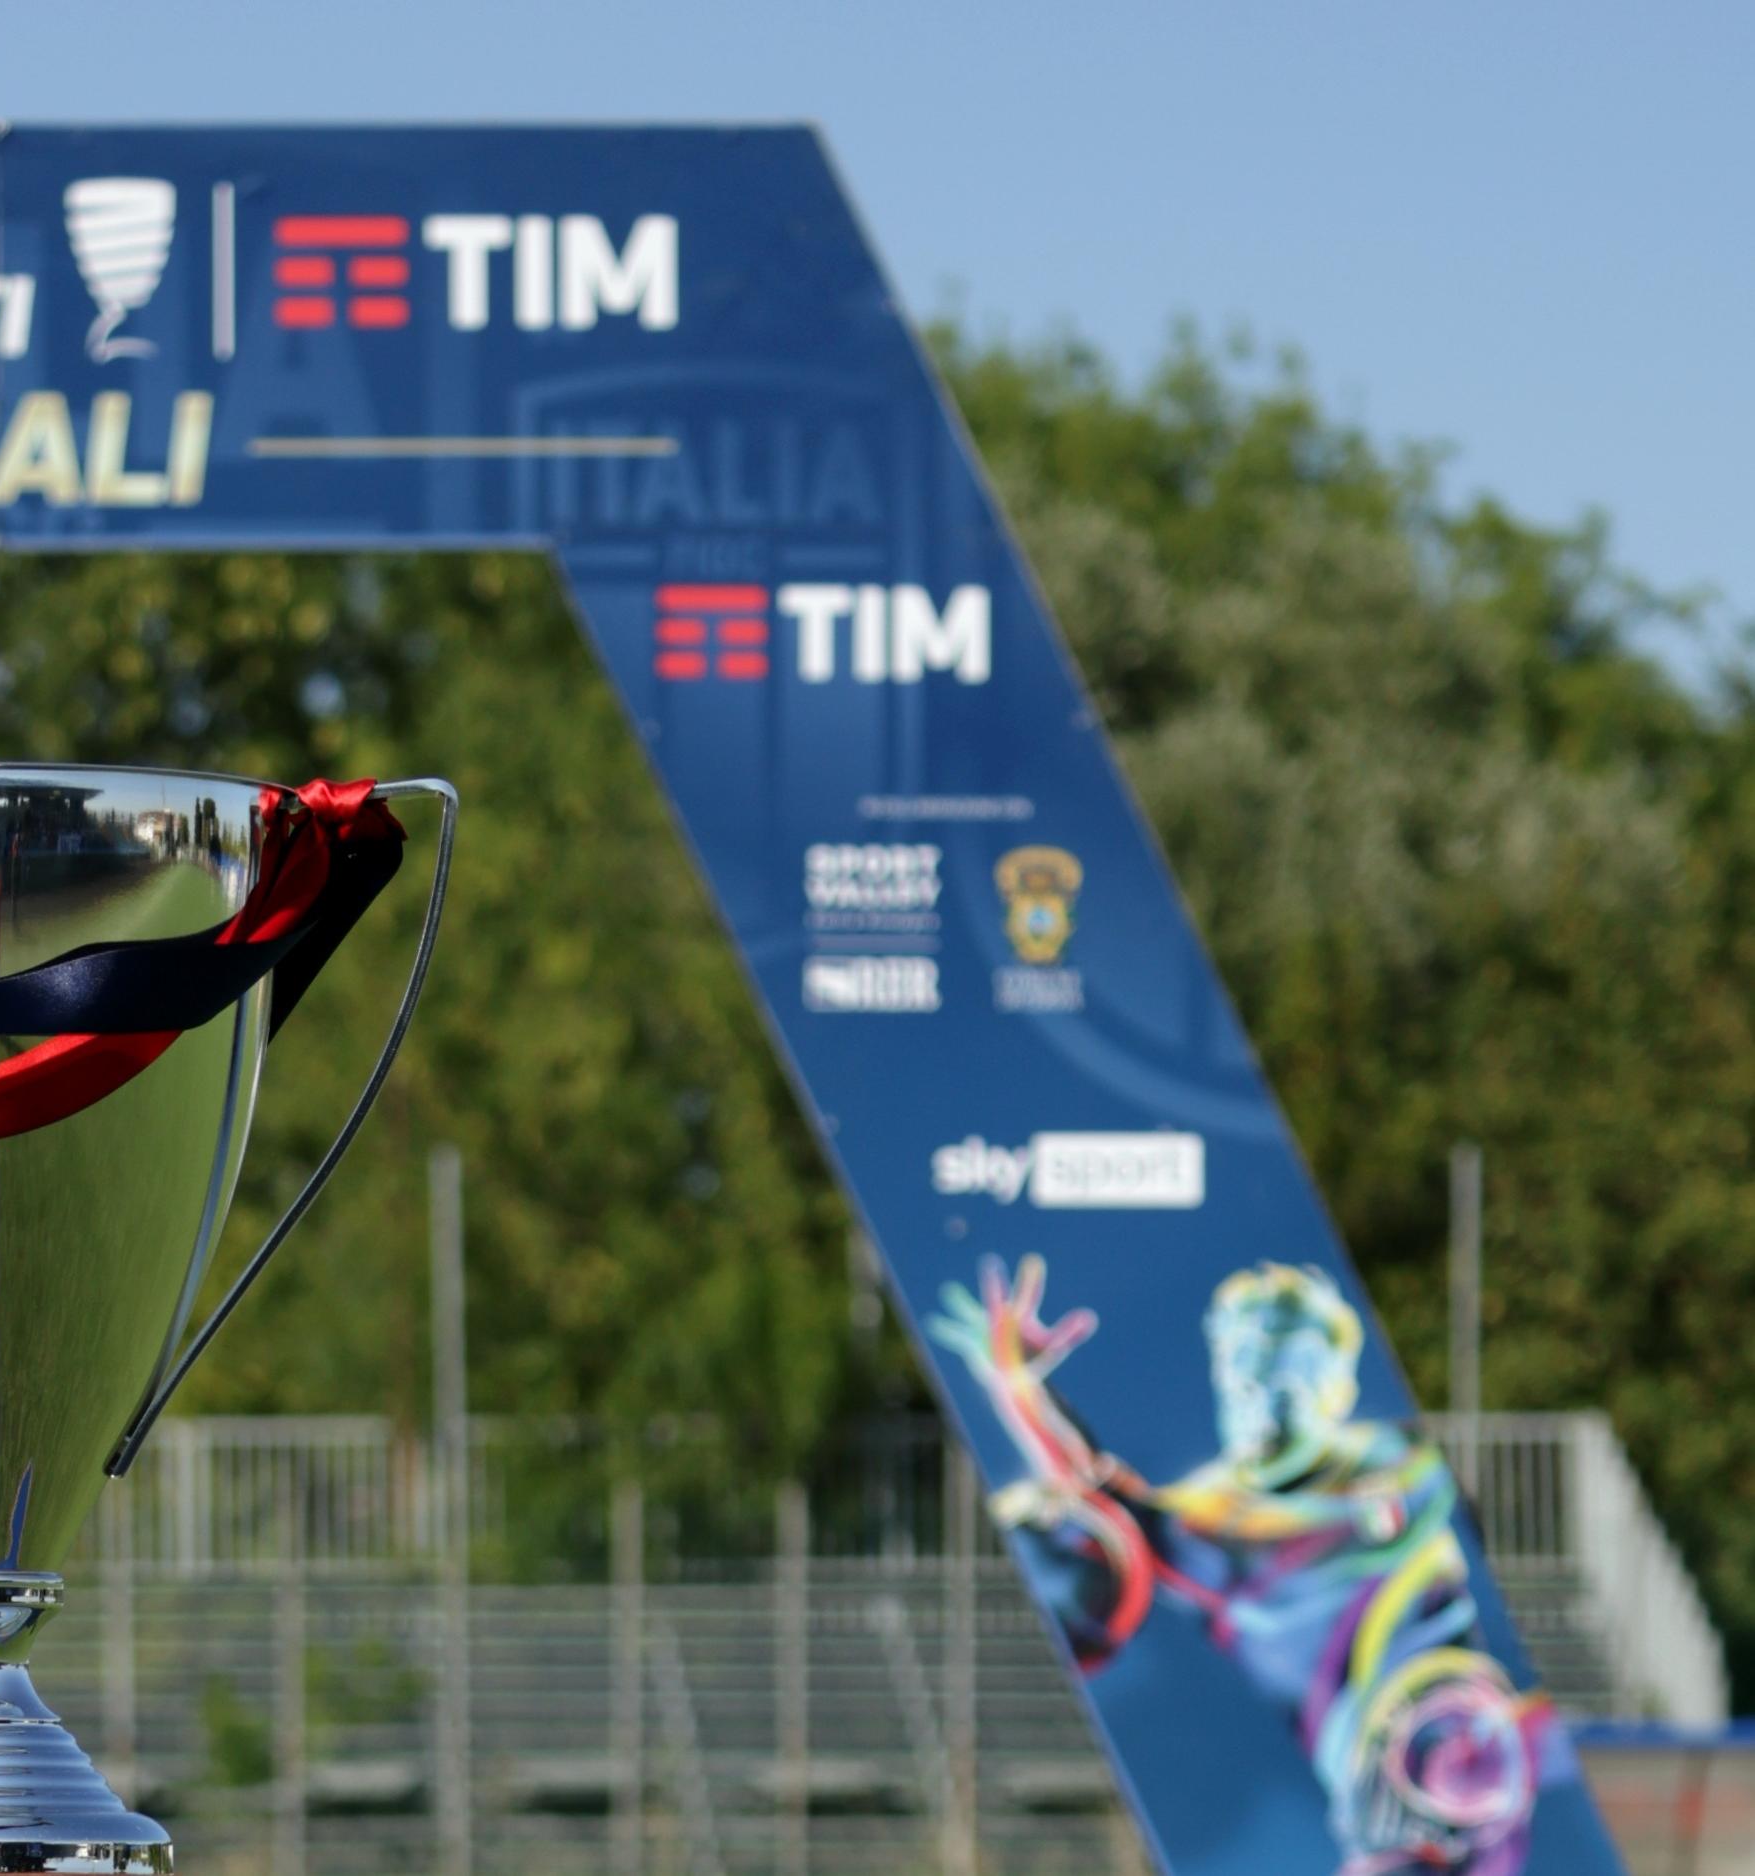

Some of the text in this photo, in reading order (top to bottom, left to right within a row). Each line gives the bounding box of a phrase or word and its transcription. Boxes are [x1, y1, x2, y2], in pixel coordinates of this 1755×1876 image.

[422, 214, 678, 331] TIM
[776, 582, 992, 685] TIM
[805, 843, 942, 876] SPORT
[805, 875, 942, 909] VALLEY
[931, 1134, 1180, 1206] sky sport
